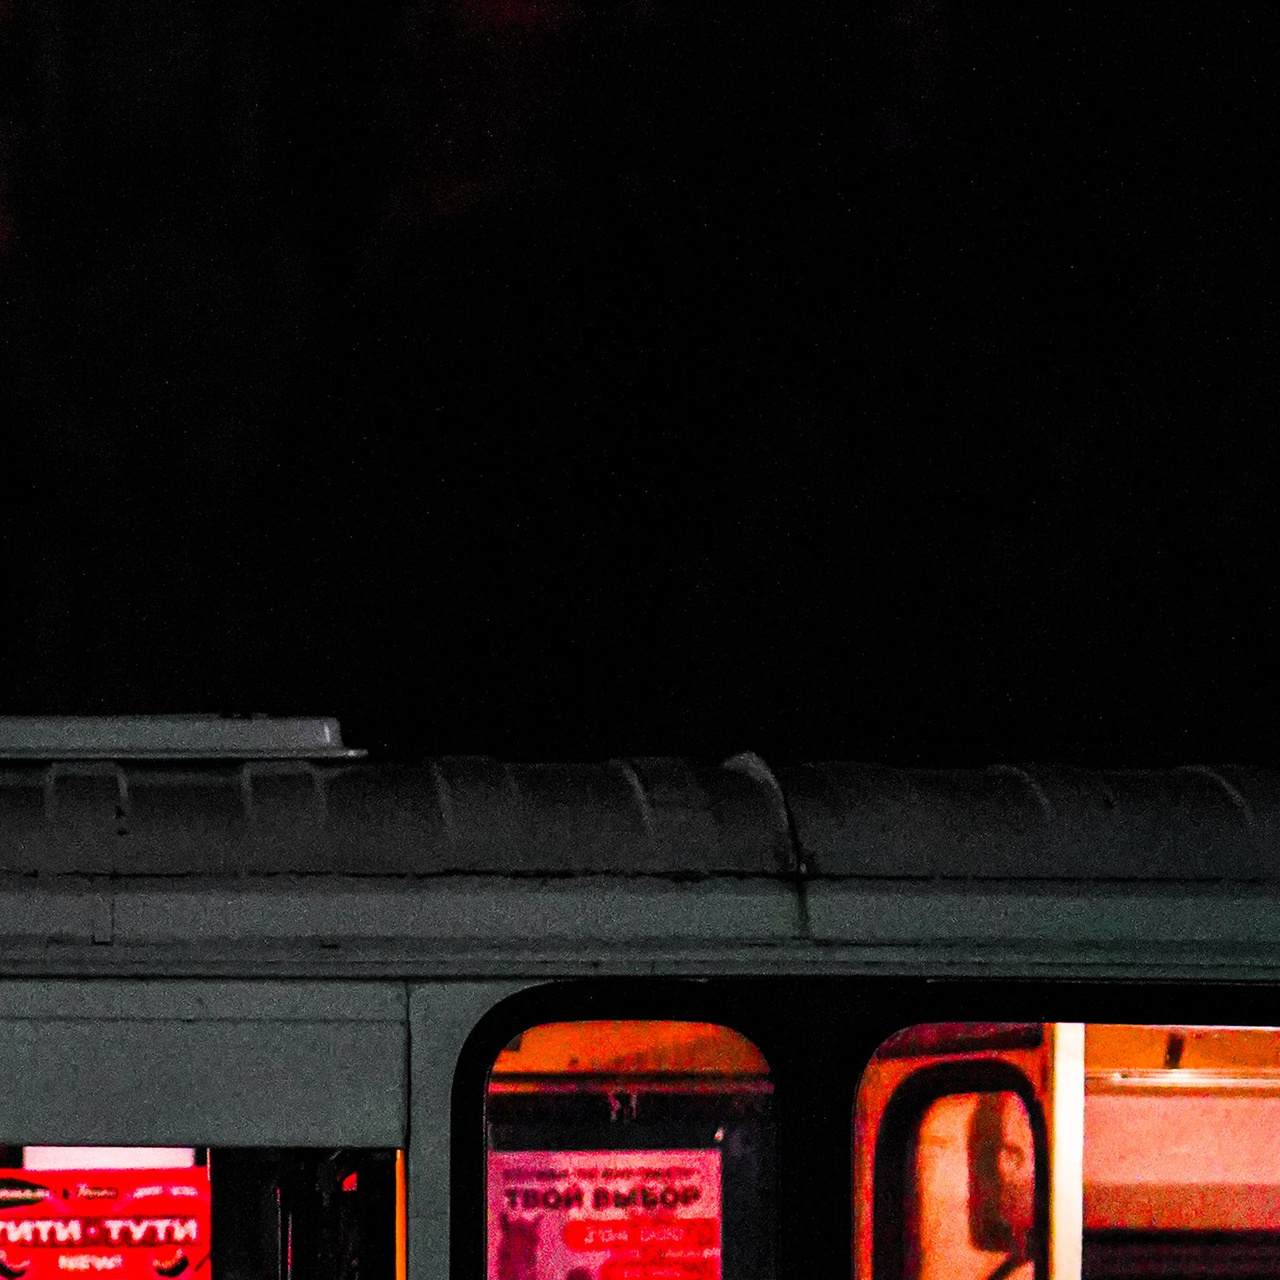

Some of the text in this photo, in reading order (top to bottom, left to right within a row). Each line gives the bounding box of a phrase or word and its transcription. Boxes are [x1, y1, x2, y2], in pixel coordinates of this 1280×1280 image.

[505, 1185, 700, 1210] ТВОЙ ВЫБОР
[104, 1219, 197, 1242] ТУТИ
